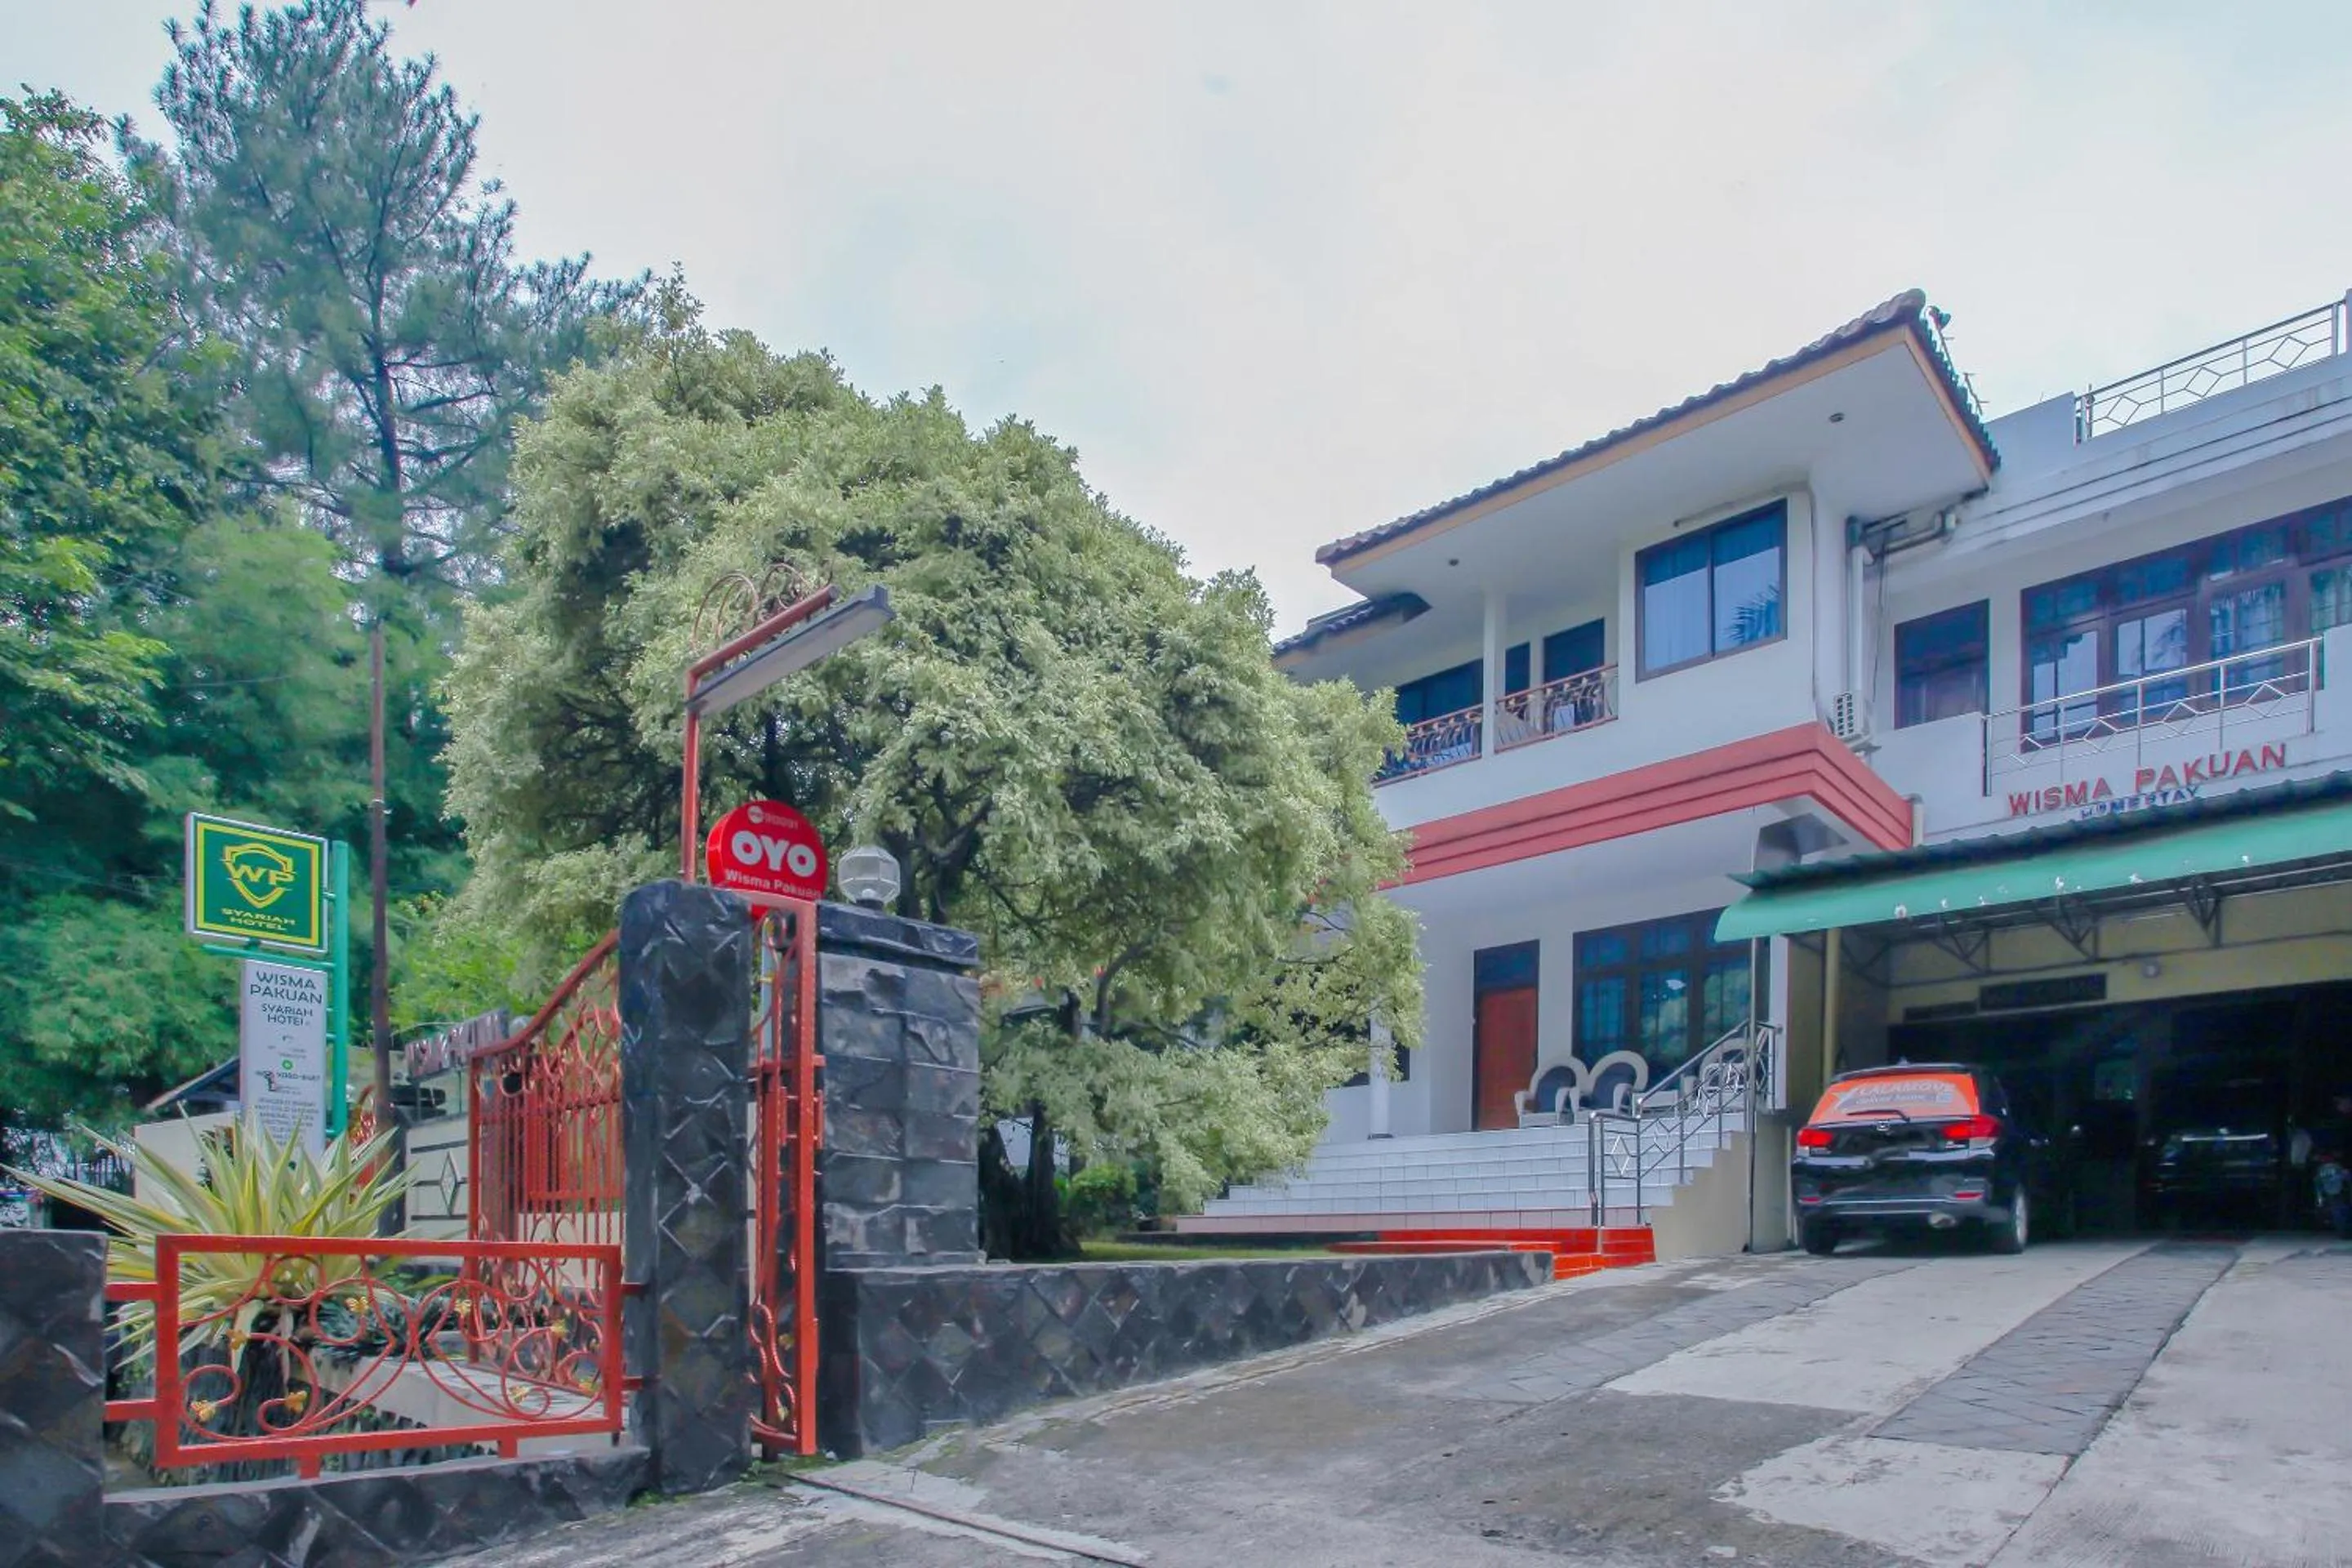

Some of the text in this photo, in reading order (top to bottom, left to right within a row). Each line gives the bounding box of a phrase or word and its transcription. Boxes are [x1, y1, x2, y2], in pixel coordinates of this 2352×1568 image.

[2008, 742, 2287, 817] WISMA PAKUAN
[732, 831, 817, 877] OYO
[725, 868, 822, 900] Wisma Pakuan
[220, 907, 296, 925] SYARIAH
[229, 916, 287, 931] HOTEL
[256, 970, 316, 990] WISMA
[250, 983, 323, 1004] PAKUAN
[261, 1003, 314, 1018] SYARIAH
